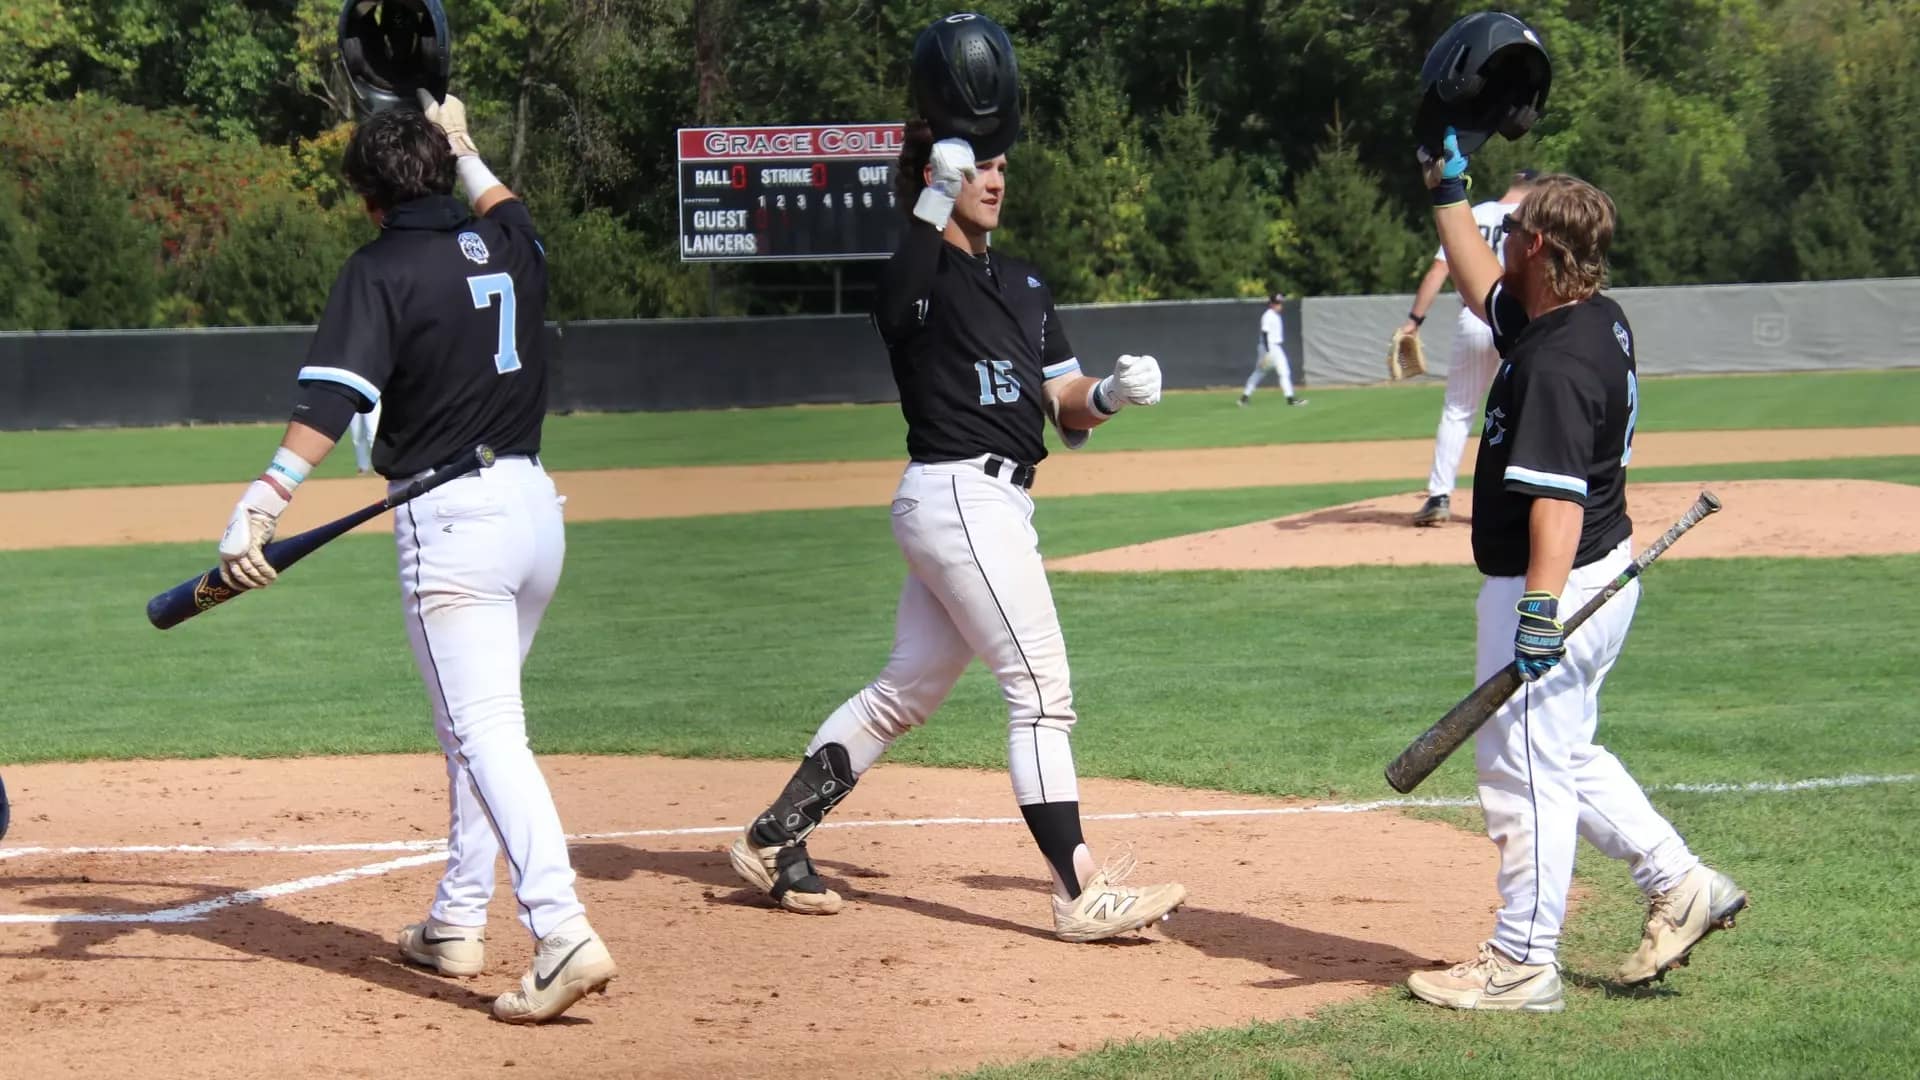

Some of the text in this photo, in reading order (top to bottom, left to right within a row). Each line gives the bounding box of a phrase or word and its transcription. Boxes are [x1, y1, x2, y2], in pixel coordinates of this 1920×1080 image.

[703, 128, 904, 155] GRACE COLL
[695, 169, 732, 186] BALL
[760, 167, 813, 186] STRIKE
[858, 166, 889, 186] OUT
[757, 195, 766, 209] 1
[776, 194, 786, 209] 2
[796, 193, 807, 210] 3
[823, 192, 832, 209] 4
[843, 192, 853, 208] 5
[693, 210, 748, 231] GUEST
[683, 233, 757, 254] LANCERS
[466, 272, 522, 375] 7
[974, 359, 1020, 405] 15
